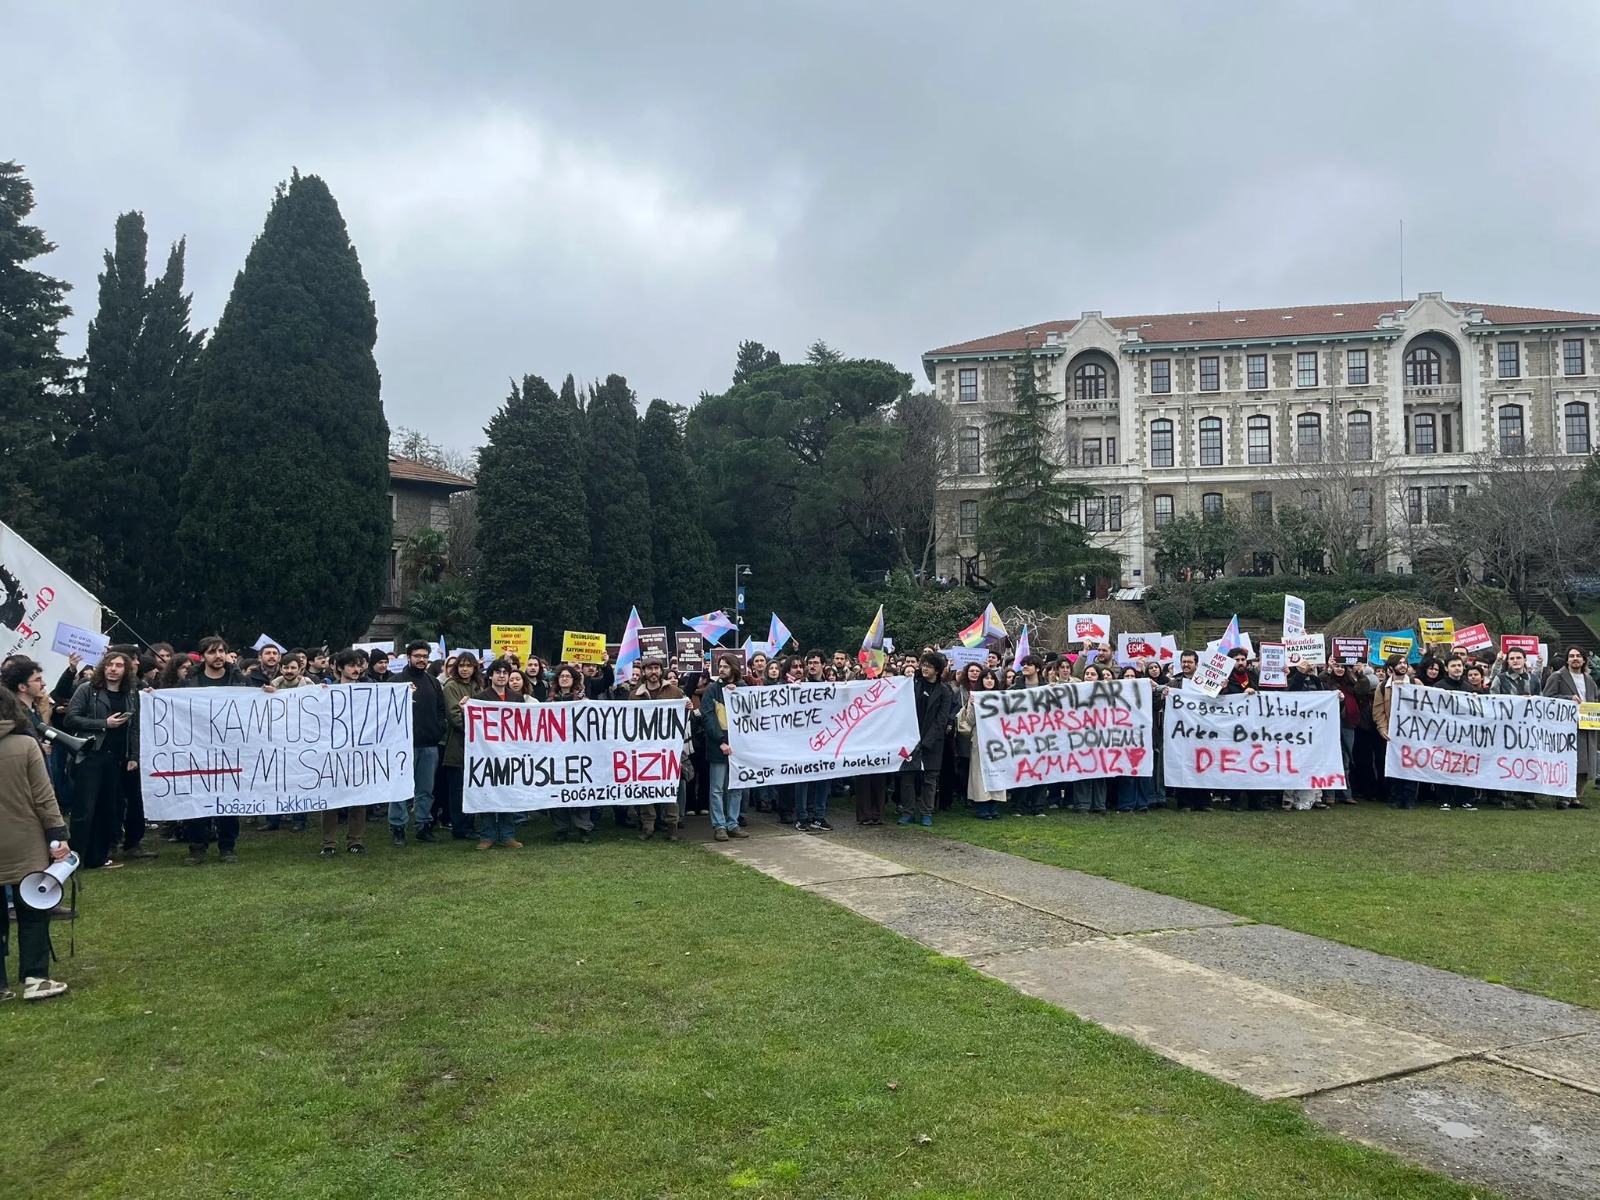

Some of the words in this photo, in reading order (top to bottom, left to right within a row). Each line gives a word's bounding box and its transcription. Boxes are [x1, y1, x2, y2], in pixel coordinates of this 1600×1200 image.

[1213, 653, 1227, 663] AKP
[1287, 643, 1323, 652] KAZANDIRIR!
[1204, 669, 1219, 680] ÇEK!
[1210, 659, 1224, 670] ELİNİ
[731, 683, 836, 714] ÜNİVERSİTELERİ
[1205, 679, 1220, 689] MFT
[809, 676, 896, 751] GELİYORUZ!
[980, 690, 1028, 719] SİZ
[1029, 681, 1142, 713] KAPILARI
[1173, 694, 1250, 717] Boğaziçi
[1396, 687, 1514, 721] HAMLİN'İN
[1523, 698, 1577, 723] AŞIĞIDIR
[153, 697, 193, 746] BU
[210, 693, 321, 744] KAMPÜS
[467, 706, 566, 742] FERMAN
[571, 706, 688, 743] KAYYUMUN
[733, 708, 822, 733] YÖNETMEYE
[1000, 707, 1133, 740] KAPARSANIZ
[1171, 720, 1218, 740] Arka
[1233, 724, 1313, 745] Bahçesi
[1396, 714, 1497, 748] KAYYUMUN
[1504, 721, 1577, 754] DÜŞMANIDIR
[986, 734, 1031, 762] BİZ
[1034, 733, 1060, 754] DE
[1067, 724, 1144, 751] DÖNEMİ
[1195, 743, 1299, 774] DEĞİL
[152, 748, 240, 797] SENİN
[250, 747, 287, 792] Mİ
[468, 754, 592, 787] KAMPÜSLER
[842, 752, 890, 767] hareketi
[1401, 744, 1480, 776] BOĞAZİÇİ
[1310, 773, 1345, 788] MFT
[276, 795, 328, 812] hakkında
